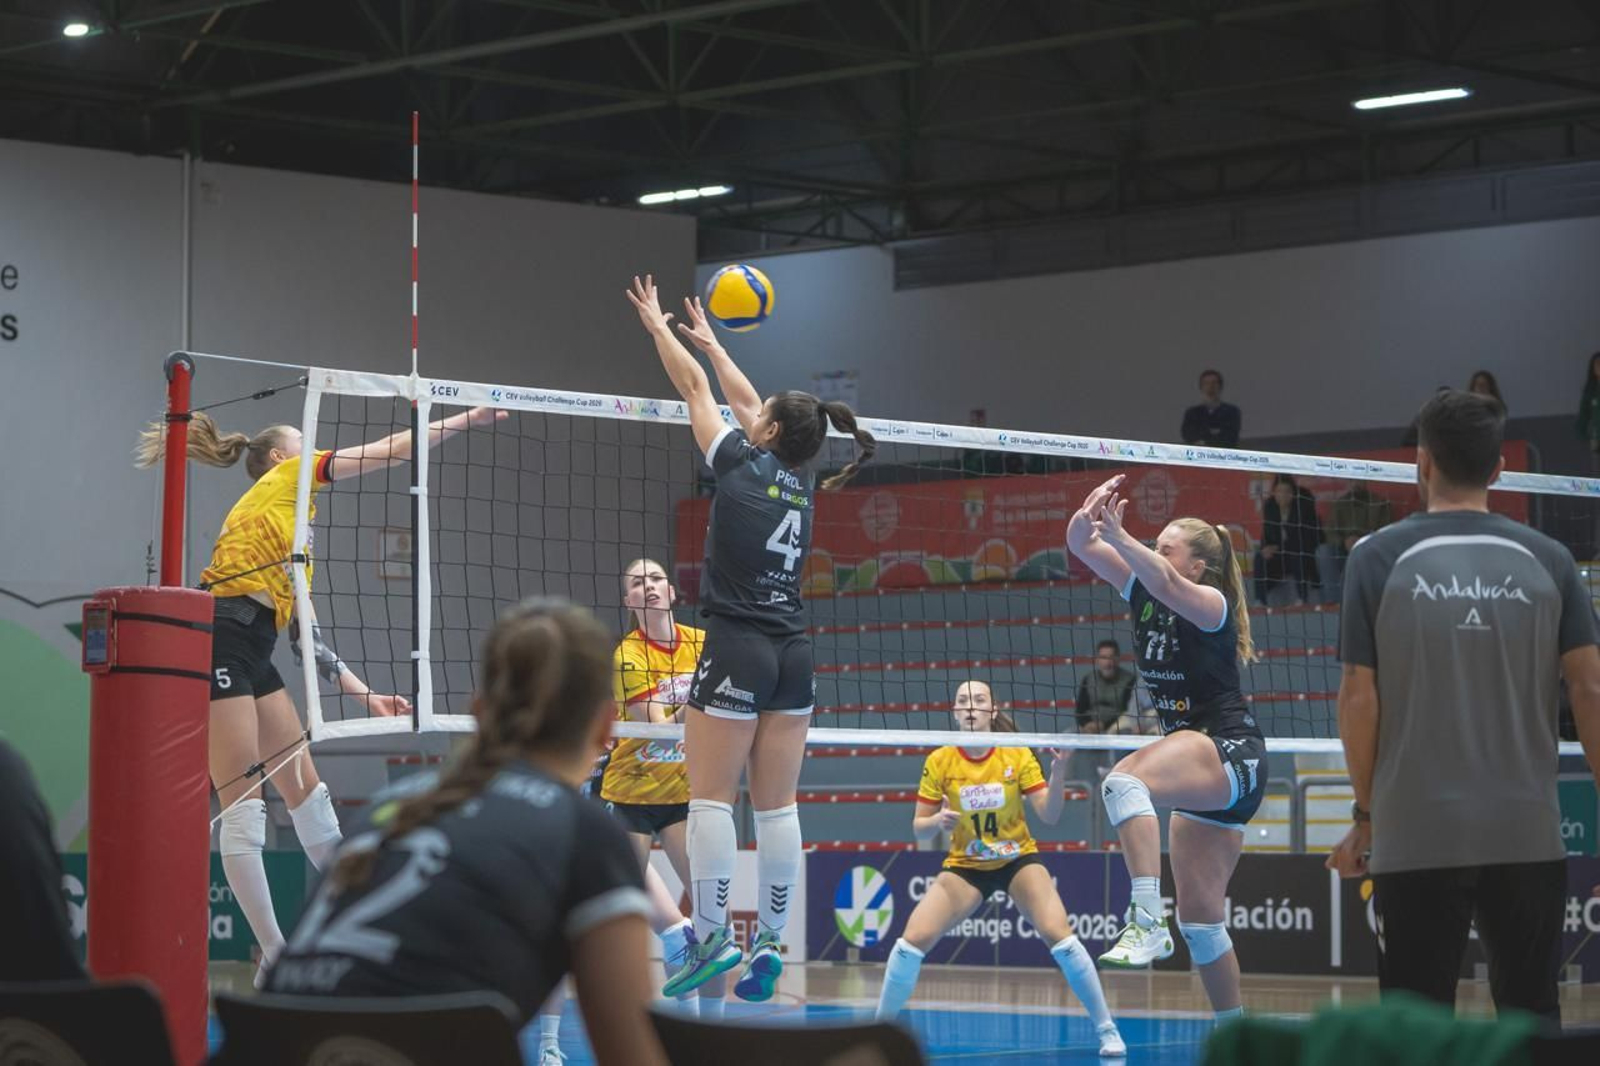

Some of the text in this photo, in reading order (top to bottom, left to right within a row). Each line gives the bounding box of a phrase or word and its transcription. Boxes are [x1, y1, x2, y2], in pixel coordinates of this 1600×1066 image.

[438, 385, 460, 397] CEV
[505, 392, 518, 401] CEV
[766, 509, 802, 572] 4
[1411, 573, 1533, 605] Andalucía
[215, 667, 232, 689] 5
[970, 811, 998, 839] 14
[1068, 913, 1119, 940] 2026
